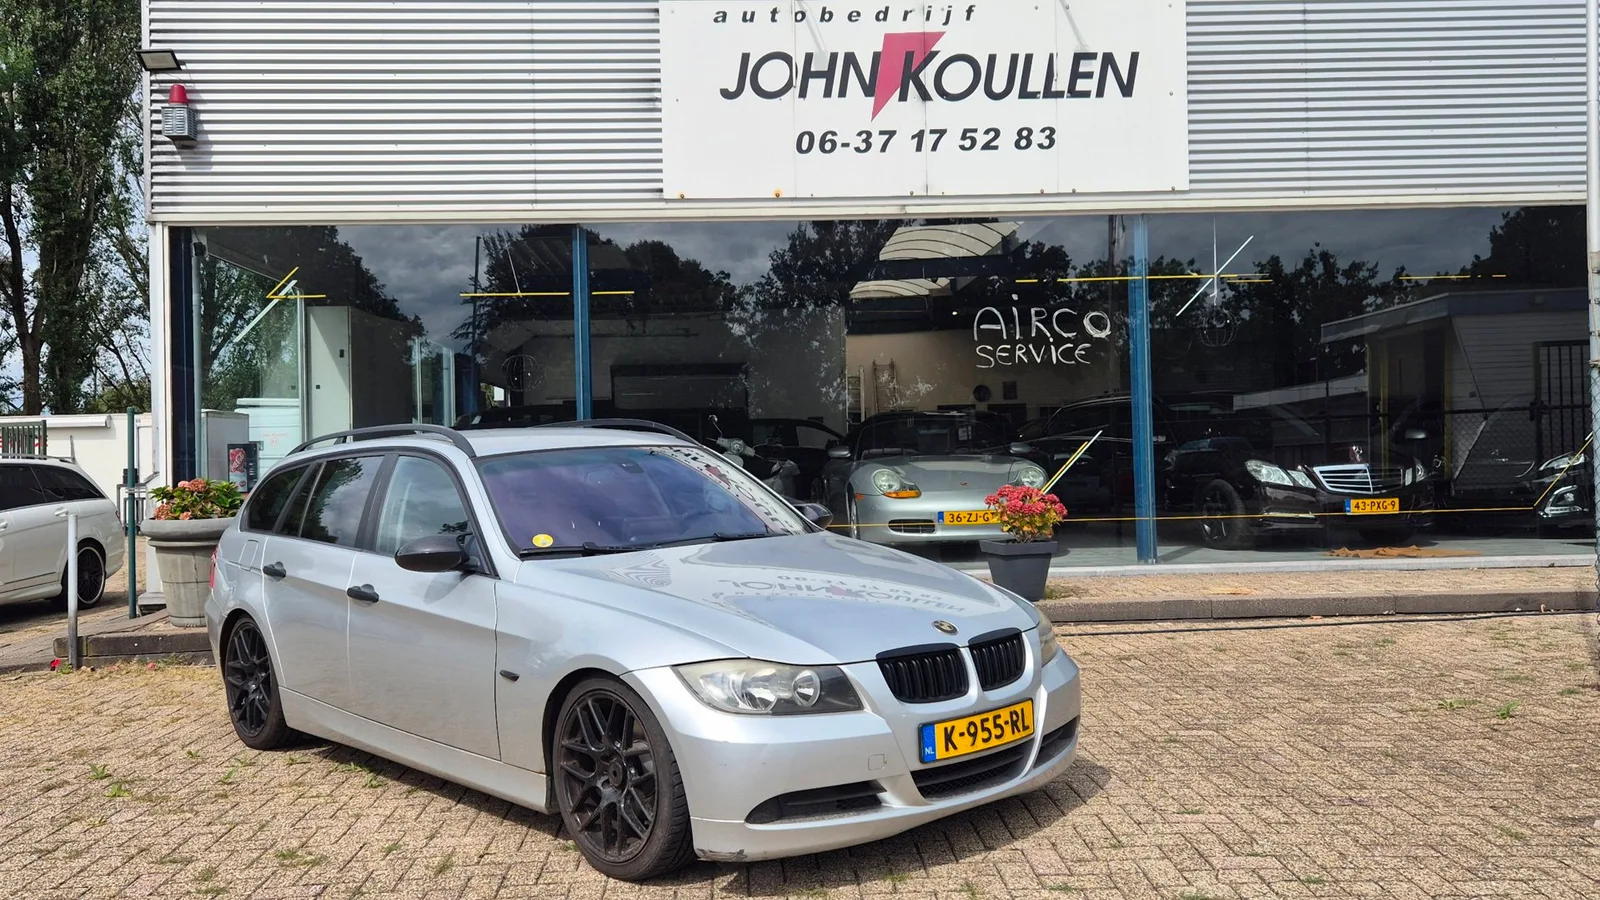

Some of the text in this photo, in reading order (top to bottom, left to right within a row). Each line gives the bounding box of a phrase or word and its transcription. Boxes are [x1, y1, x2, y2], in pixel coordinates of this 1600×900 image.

[713, 5, 976, 26] autobedrijf
[719, 50, 1140, 102] JOHN KOULLEN
[795, 126, 1057, 154] 06-37 17 52 83
[1354, 500, 1396, 511] 43-PXG-9
[943, 707, 1031, 752] K-955-RL
[925, 747, 934, 755] NL
